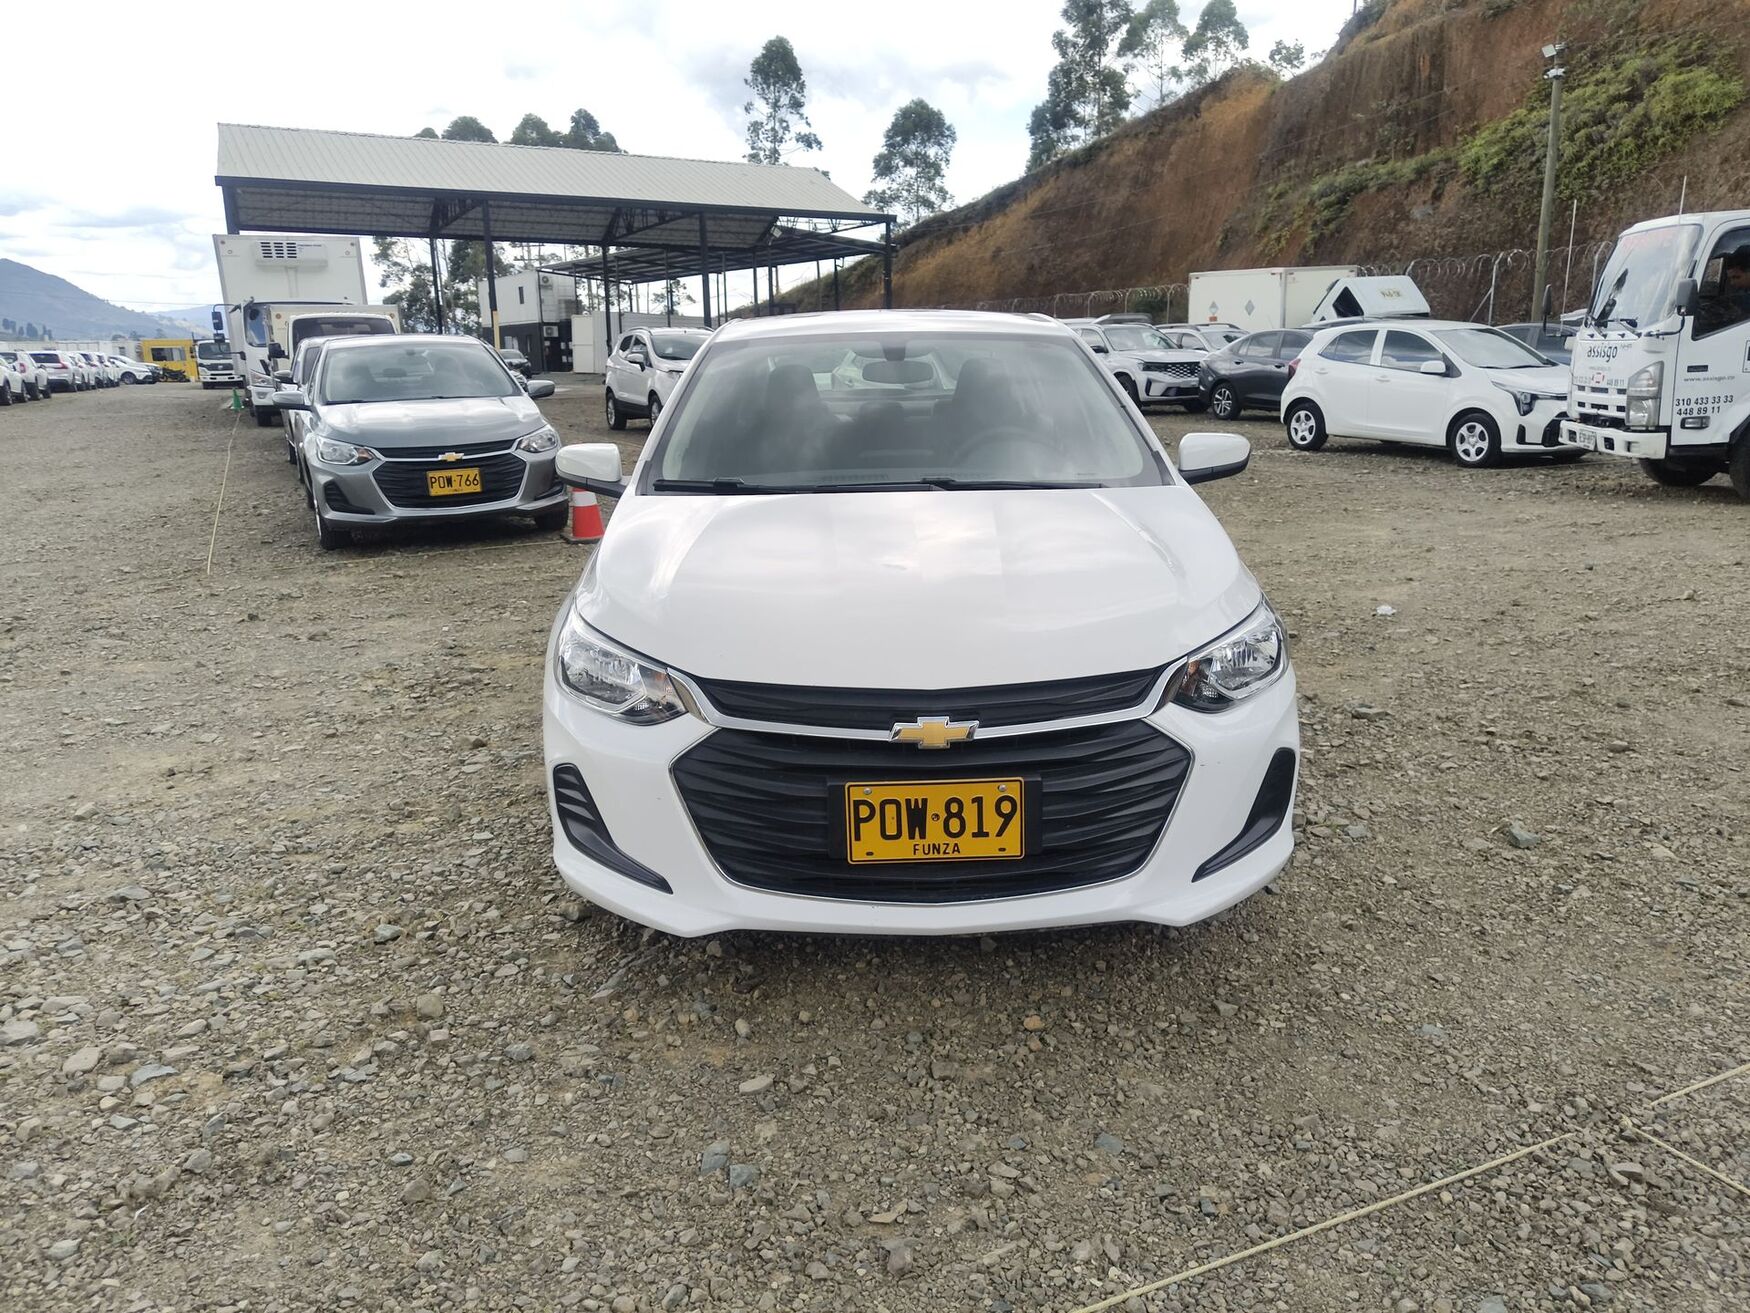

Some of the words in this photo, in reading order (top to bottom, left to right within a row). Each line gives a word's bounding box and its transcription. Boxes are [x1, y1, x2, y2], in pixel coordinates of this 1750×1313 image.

[1587, 342, 1618, 362] assisgo
[1675, 397, 1692, 407] 310
[1694, 396, 1709, 406] 433
[1711, 395, 1721, 405] 33
[1723, 394, 1734, 404] 33
[1676, 407, 1694, 416] 448
[1696, 406, 1708, 415] 89
[1711, 405, 1721, 414] 11
[912, 842, 961, 856] FUNZA
